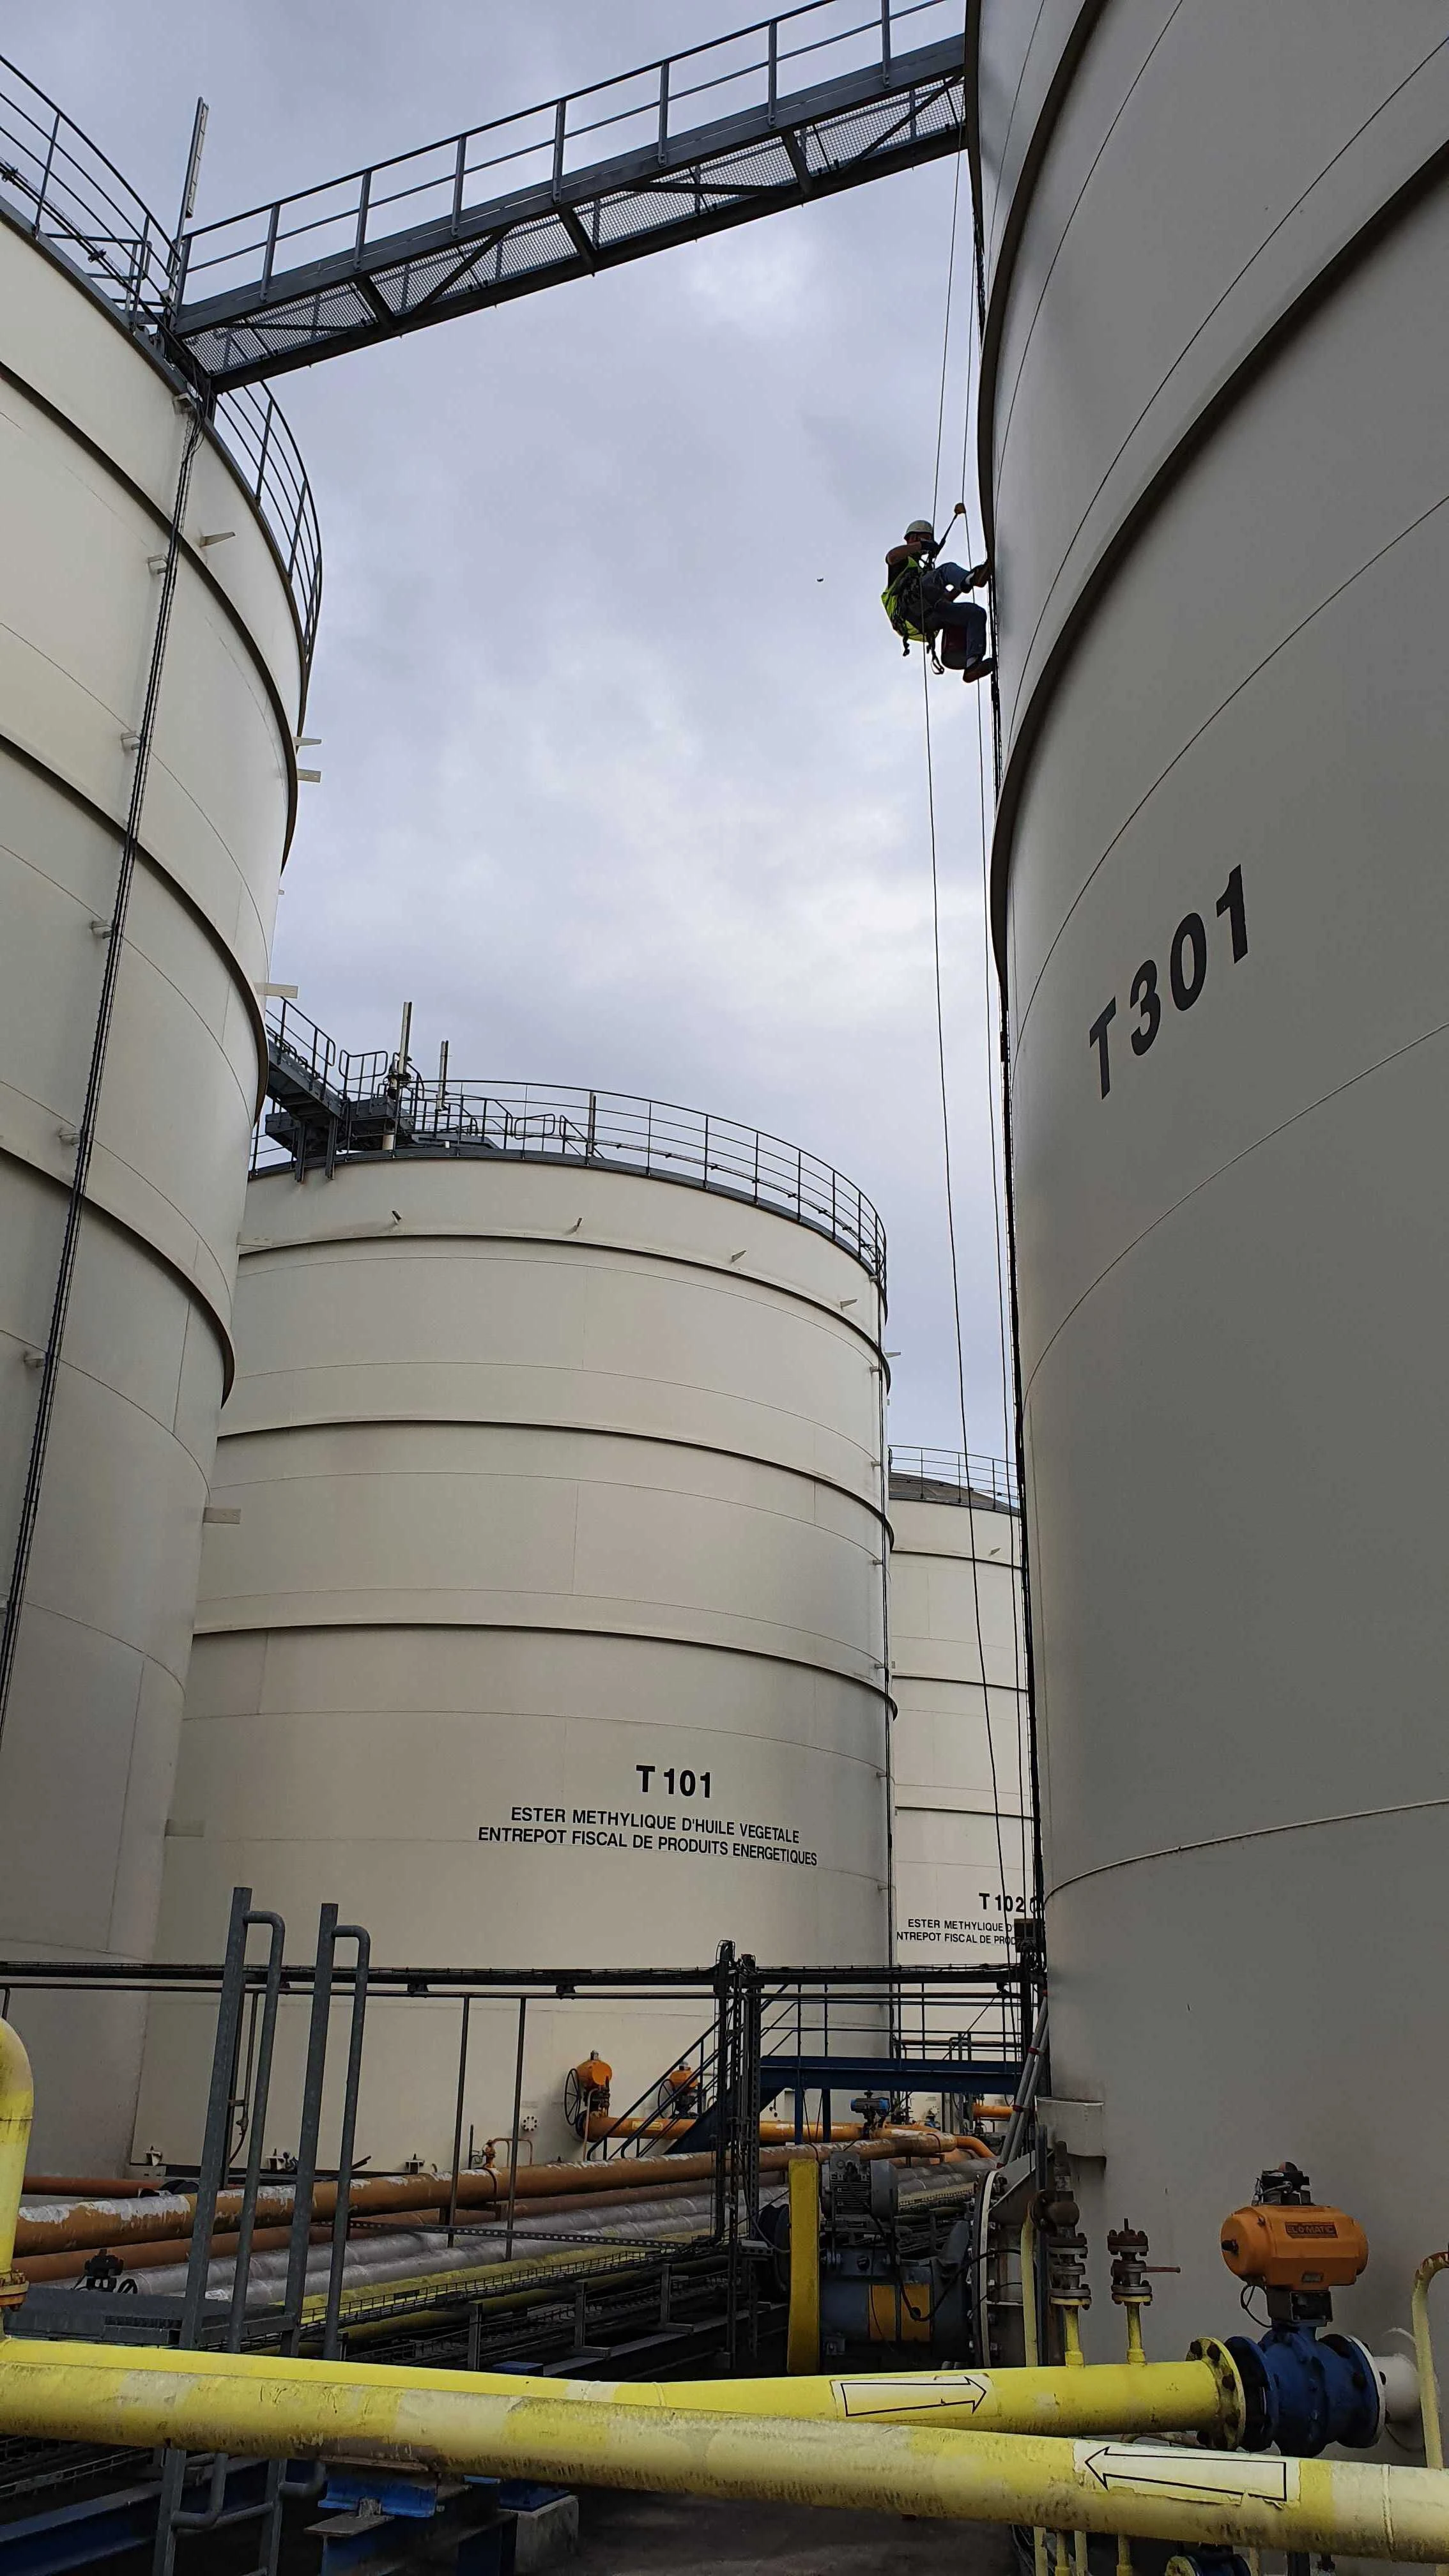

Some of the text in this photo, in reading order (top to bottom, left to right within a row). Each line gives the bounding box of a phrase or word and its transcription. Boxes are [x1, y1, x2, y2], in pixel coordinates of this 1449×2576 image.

[1089, 864, 1248, 1100] T301
[511, 1807, 800, 1844] ESTER METHYLIQUE D'HUILE VEGETALE
[479, 1827, 818, 1866] ENTREPOT FISCAL DE PRODUITS ENERGETIQUES
[896, 1931, 1016, 1946] NTREPOT FISCAL DE PROD
[908, 1919, 940, 1929] ESTER
[944, 1920, 1004, 1932] METHYLIQUE
